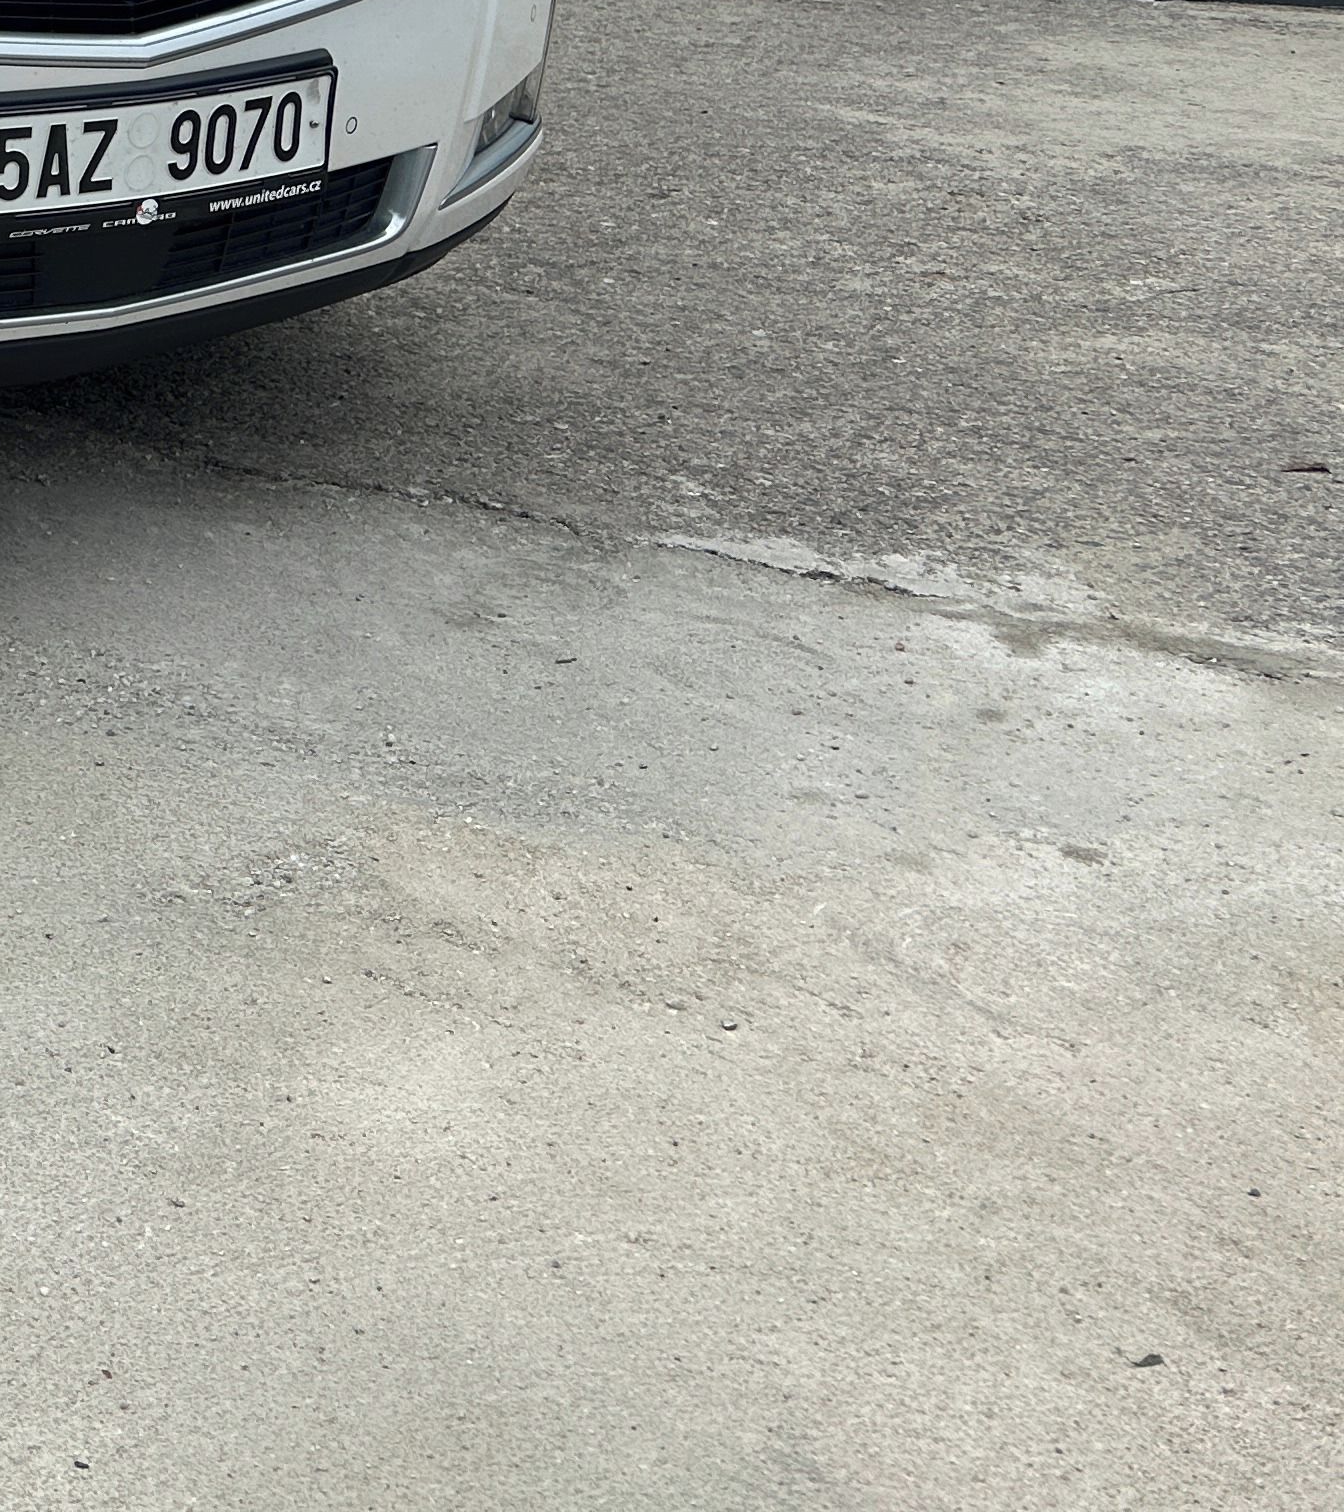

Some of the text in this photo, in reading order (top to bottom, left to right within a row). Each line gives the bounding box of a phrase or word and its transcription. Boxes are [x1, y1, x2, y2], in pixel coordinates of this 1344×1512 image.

[167, 91, 303, 180] 9070
[209, 180, 322, 212] www.unitedcars.cz
[9, 223, 92, 239] CORVETTE
